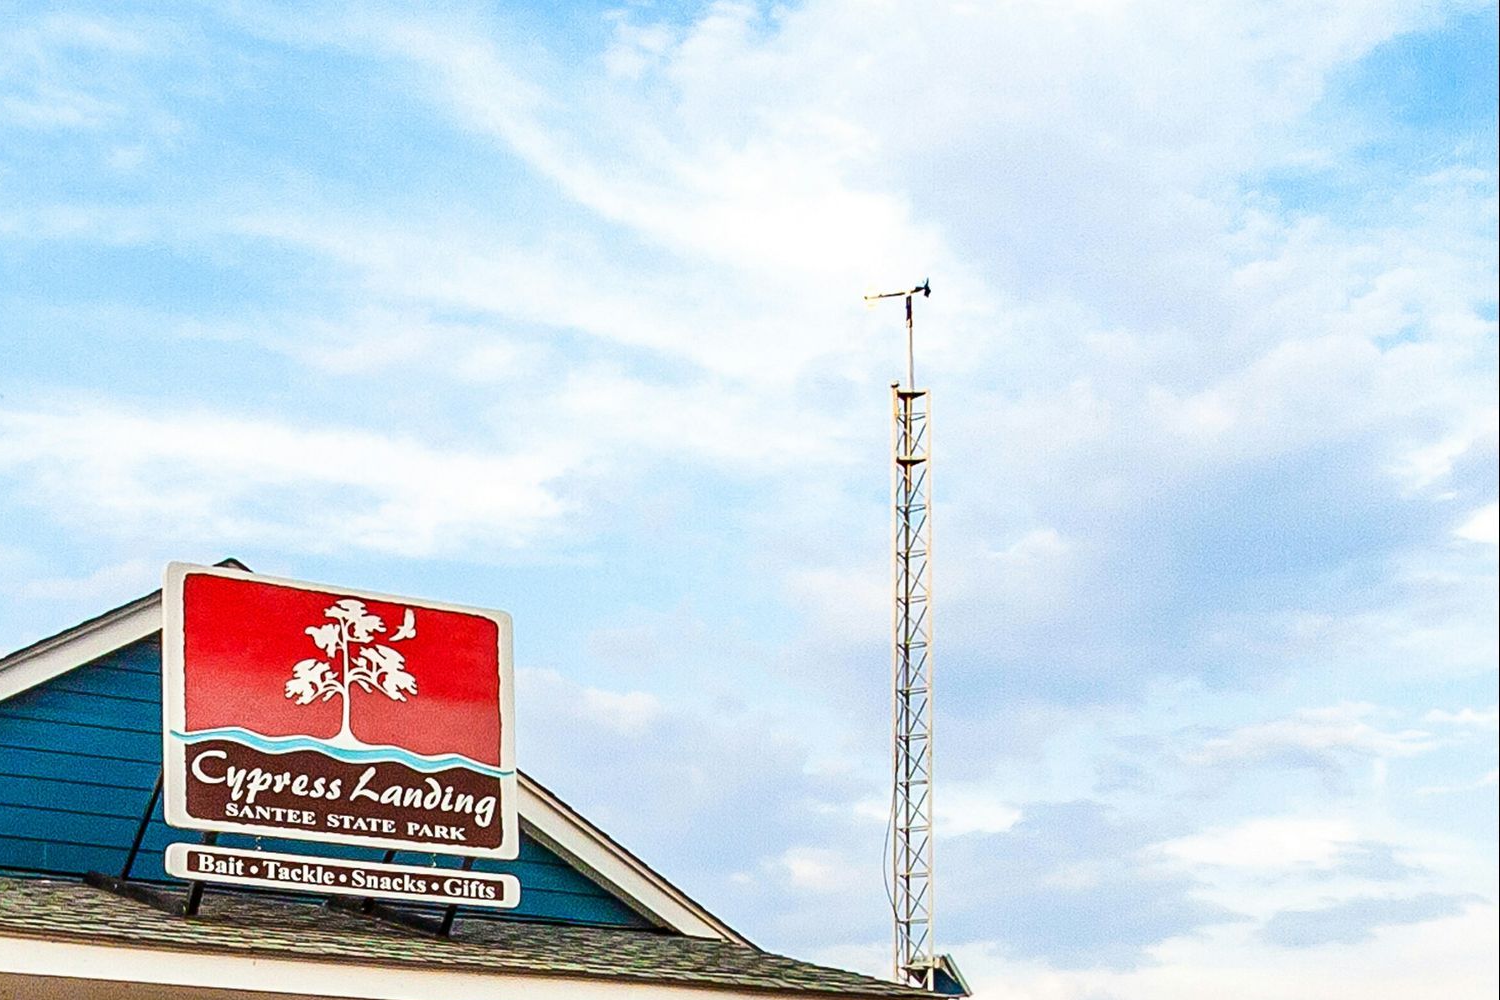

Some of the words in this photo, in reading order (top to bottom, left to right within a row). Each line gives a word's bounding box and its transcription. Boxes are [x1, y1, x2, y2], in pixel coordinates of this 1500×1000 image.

[192, 750, 342, 804] Cypress
[350, 767, 496, 827] Landing
[225, 803, 316, 825] SANTEE
[327, 814, 396, 833] STATE
[407, 822, 466, 841] PARK
[198, 854, 244, 876] Bait
[263, 861, 335, 884] Tackle
[352, 870, 426, 893] Snacks
[444, 878, 496, 899] Gifts
